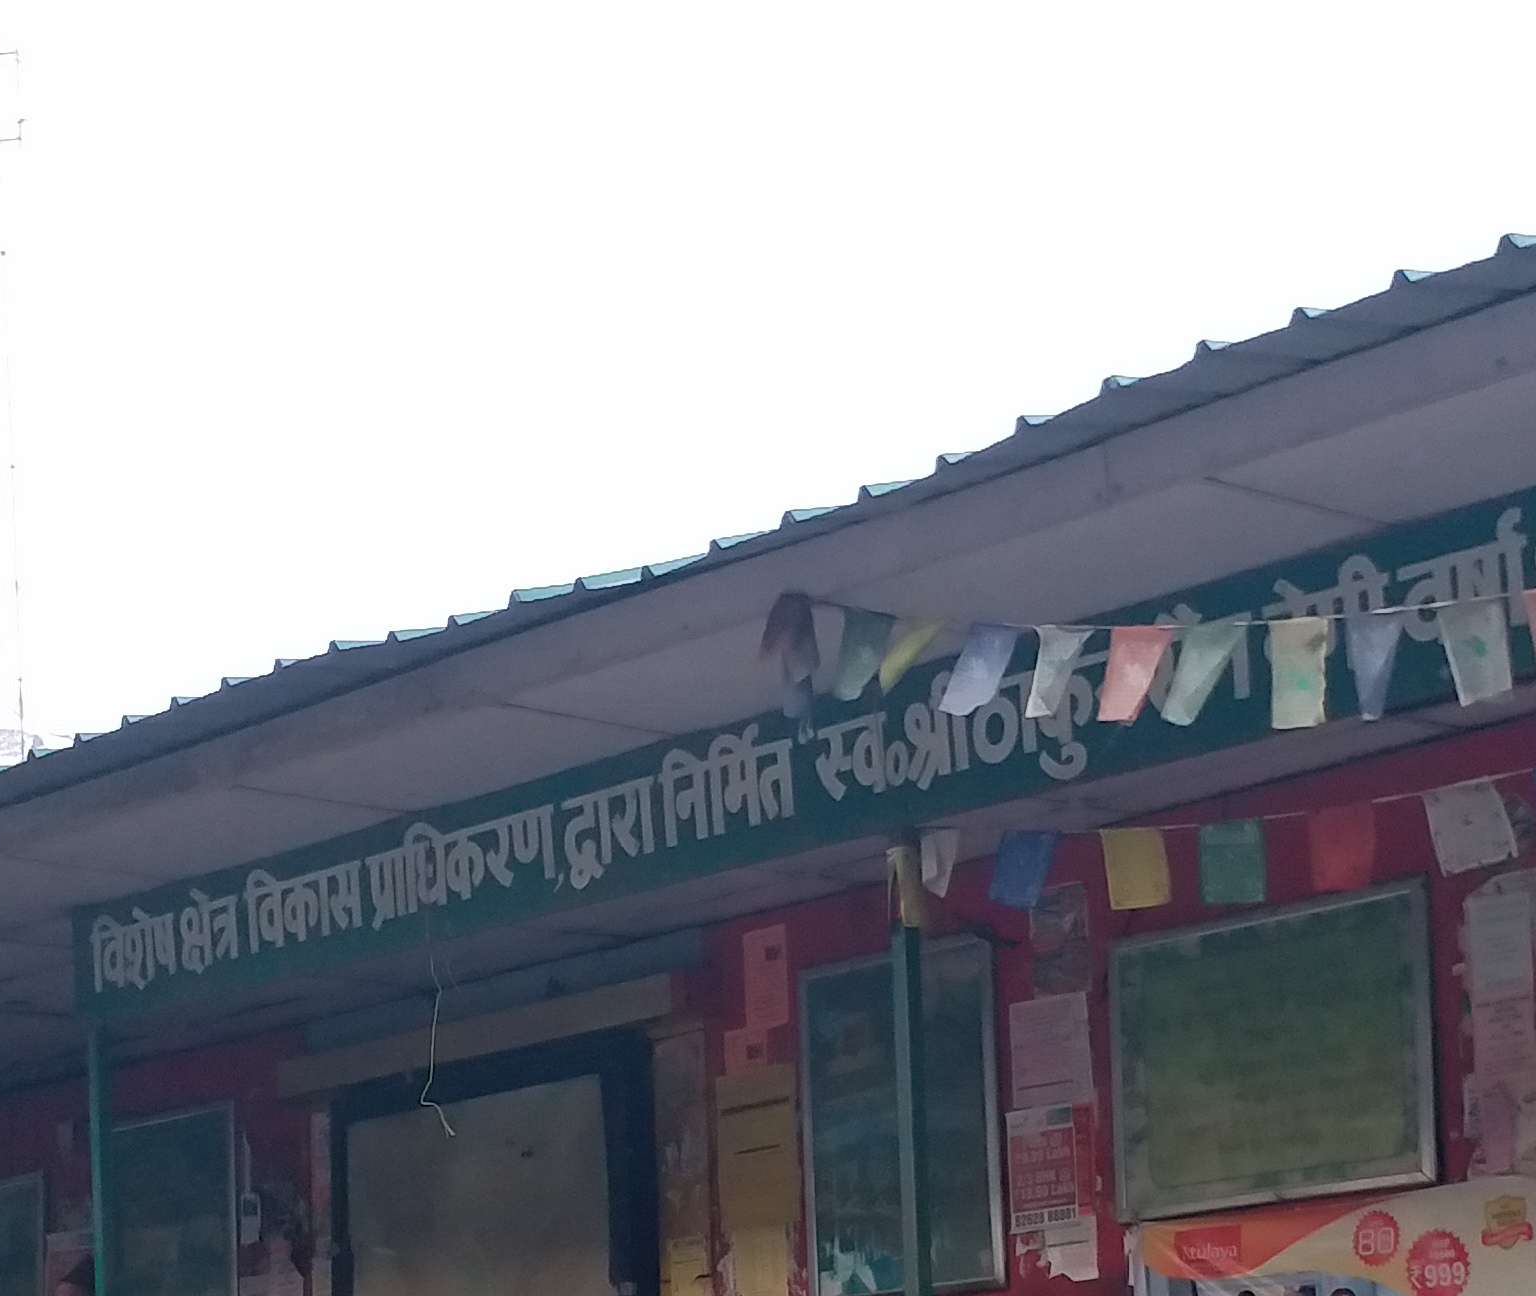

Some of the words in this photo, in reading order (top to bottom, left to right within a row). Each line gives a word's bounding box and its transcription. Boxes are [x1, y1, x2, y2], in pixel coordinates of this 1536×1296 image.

[90, 906, 176, 993] विशेष
[180, 888, 238, 975] क्षेत्र
[244, 868, 363, 954] विकास
[562, 776, 655, 890] द्वारा
[659, 723, 795, 848] निर्मित
